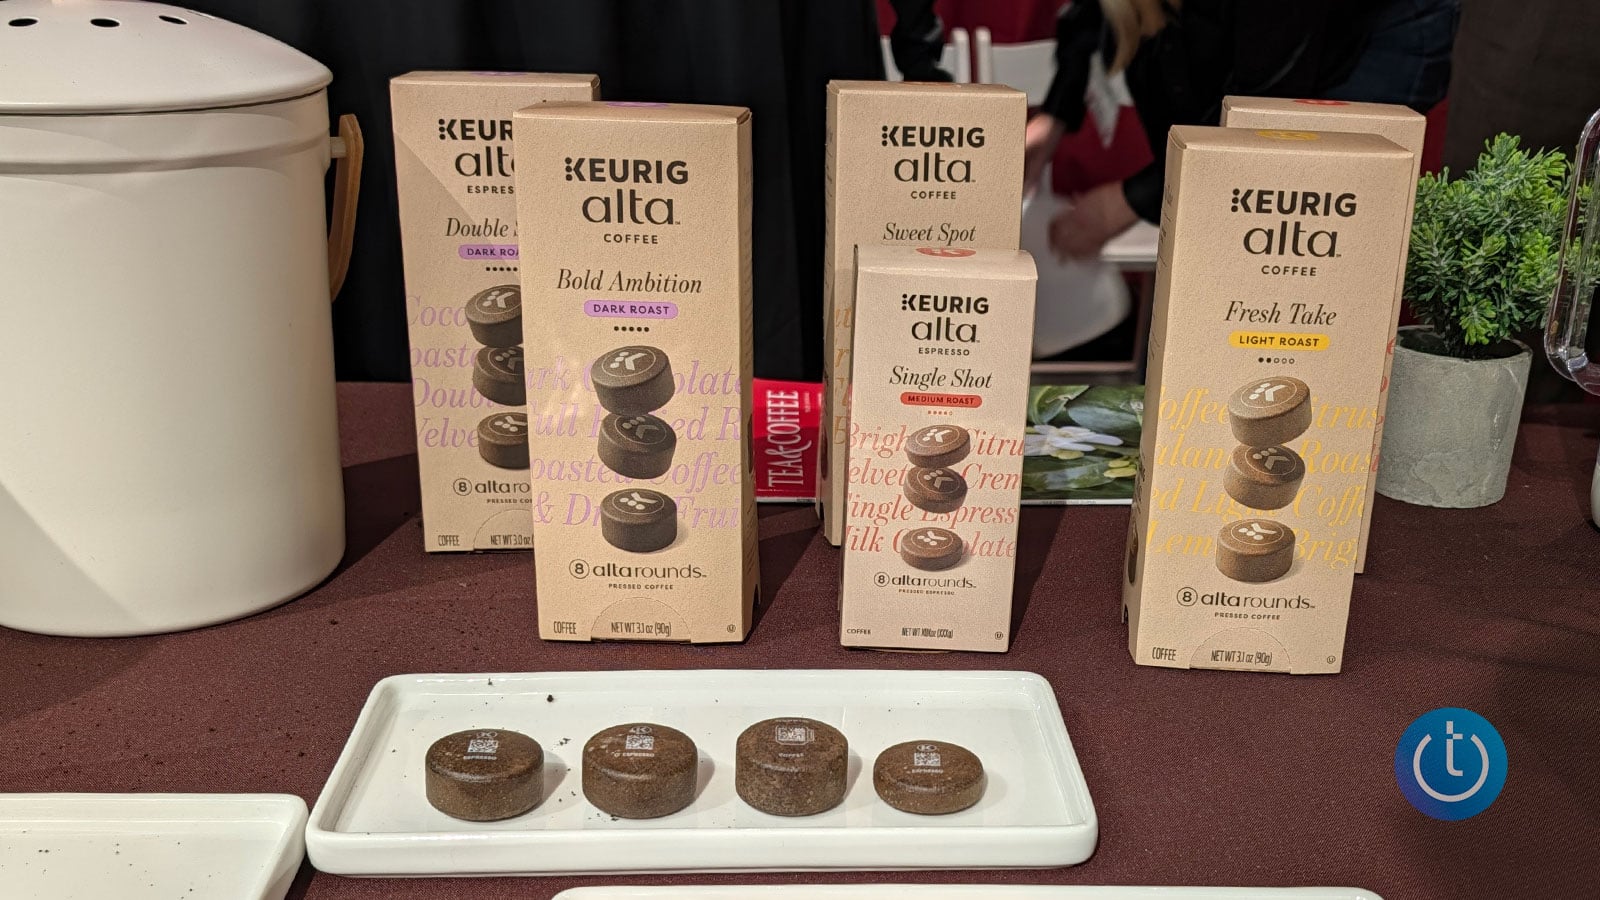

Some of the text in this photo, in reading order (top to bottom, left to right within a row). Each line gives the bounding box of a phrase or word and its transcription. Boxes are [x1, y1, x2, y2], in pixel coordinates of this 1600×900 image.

[881, 125, 985, 148] KEURIG
[455, 146, 515, 177] alt
[894, 152, 971, 183] alta
[565, 157, 689, 185] KEURIG
[911, 191, 957, 200] COFFEE
[1231, 188, 1357, 217] KEURIG
[582, 188, 674, 226] alta
[445, 217, 509, 238] Double
[883, 222, 977, 247] Sweet Spot
[603, 233, 659, 244] COFFEE
[1243, 221, 1338, 258] alta
[467, 248, 496, 256] DARK
[1261, 265, 1318, 276] COFFEE
[557, 268, 702, 294] Bold Ambition
[593, 304, 670, 315] DARK ROAST
[901, 293, 990, 315] KEURIG
[1224, 300, 1337, 326] Fresh Take
[911, 317, 977, 343] alta
[1239, 335, 1320, 347] LIGHT ROAST
[918, 347, 970, 357] ESPRESSO
[889, 365, 993, 391] Single Shot
[946, 396, 975, 405] ROAST
[438, 535, 459, 547] COFFEE
[490, 535, 501, 546] NET
[503, 535, 512, 546] WT
[553, 622, 576, 635] COFFEE
[611, 622, 624, 634] NET
[624, 622, 635, 634] WT
[645, 625, 654, 634] oz
[654, 622, 672, 637] (90g)
[1152, 647, 1176, 661] COFFEE
[1211, 650, 1224, 662] NET
[1224, 650, 1235, 662] WT
[1245, 654, 1254, 663] oz
[1254, 652, 1273, 666] (90g)
